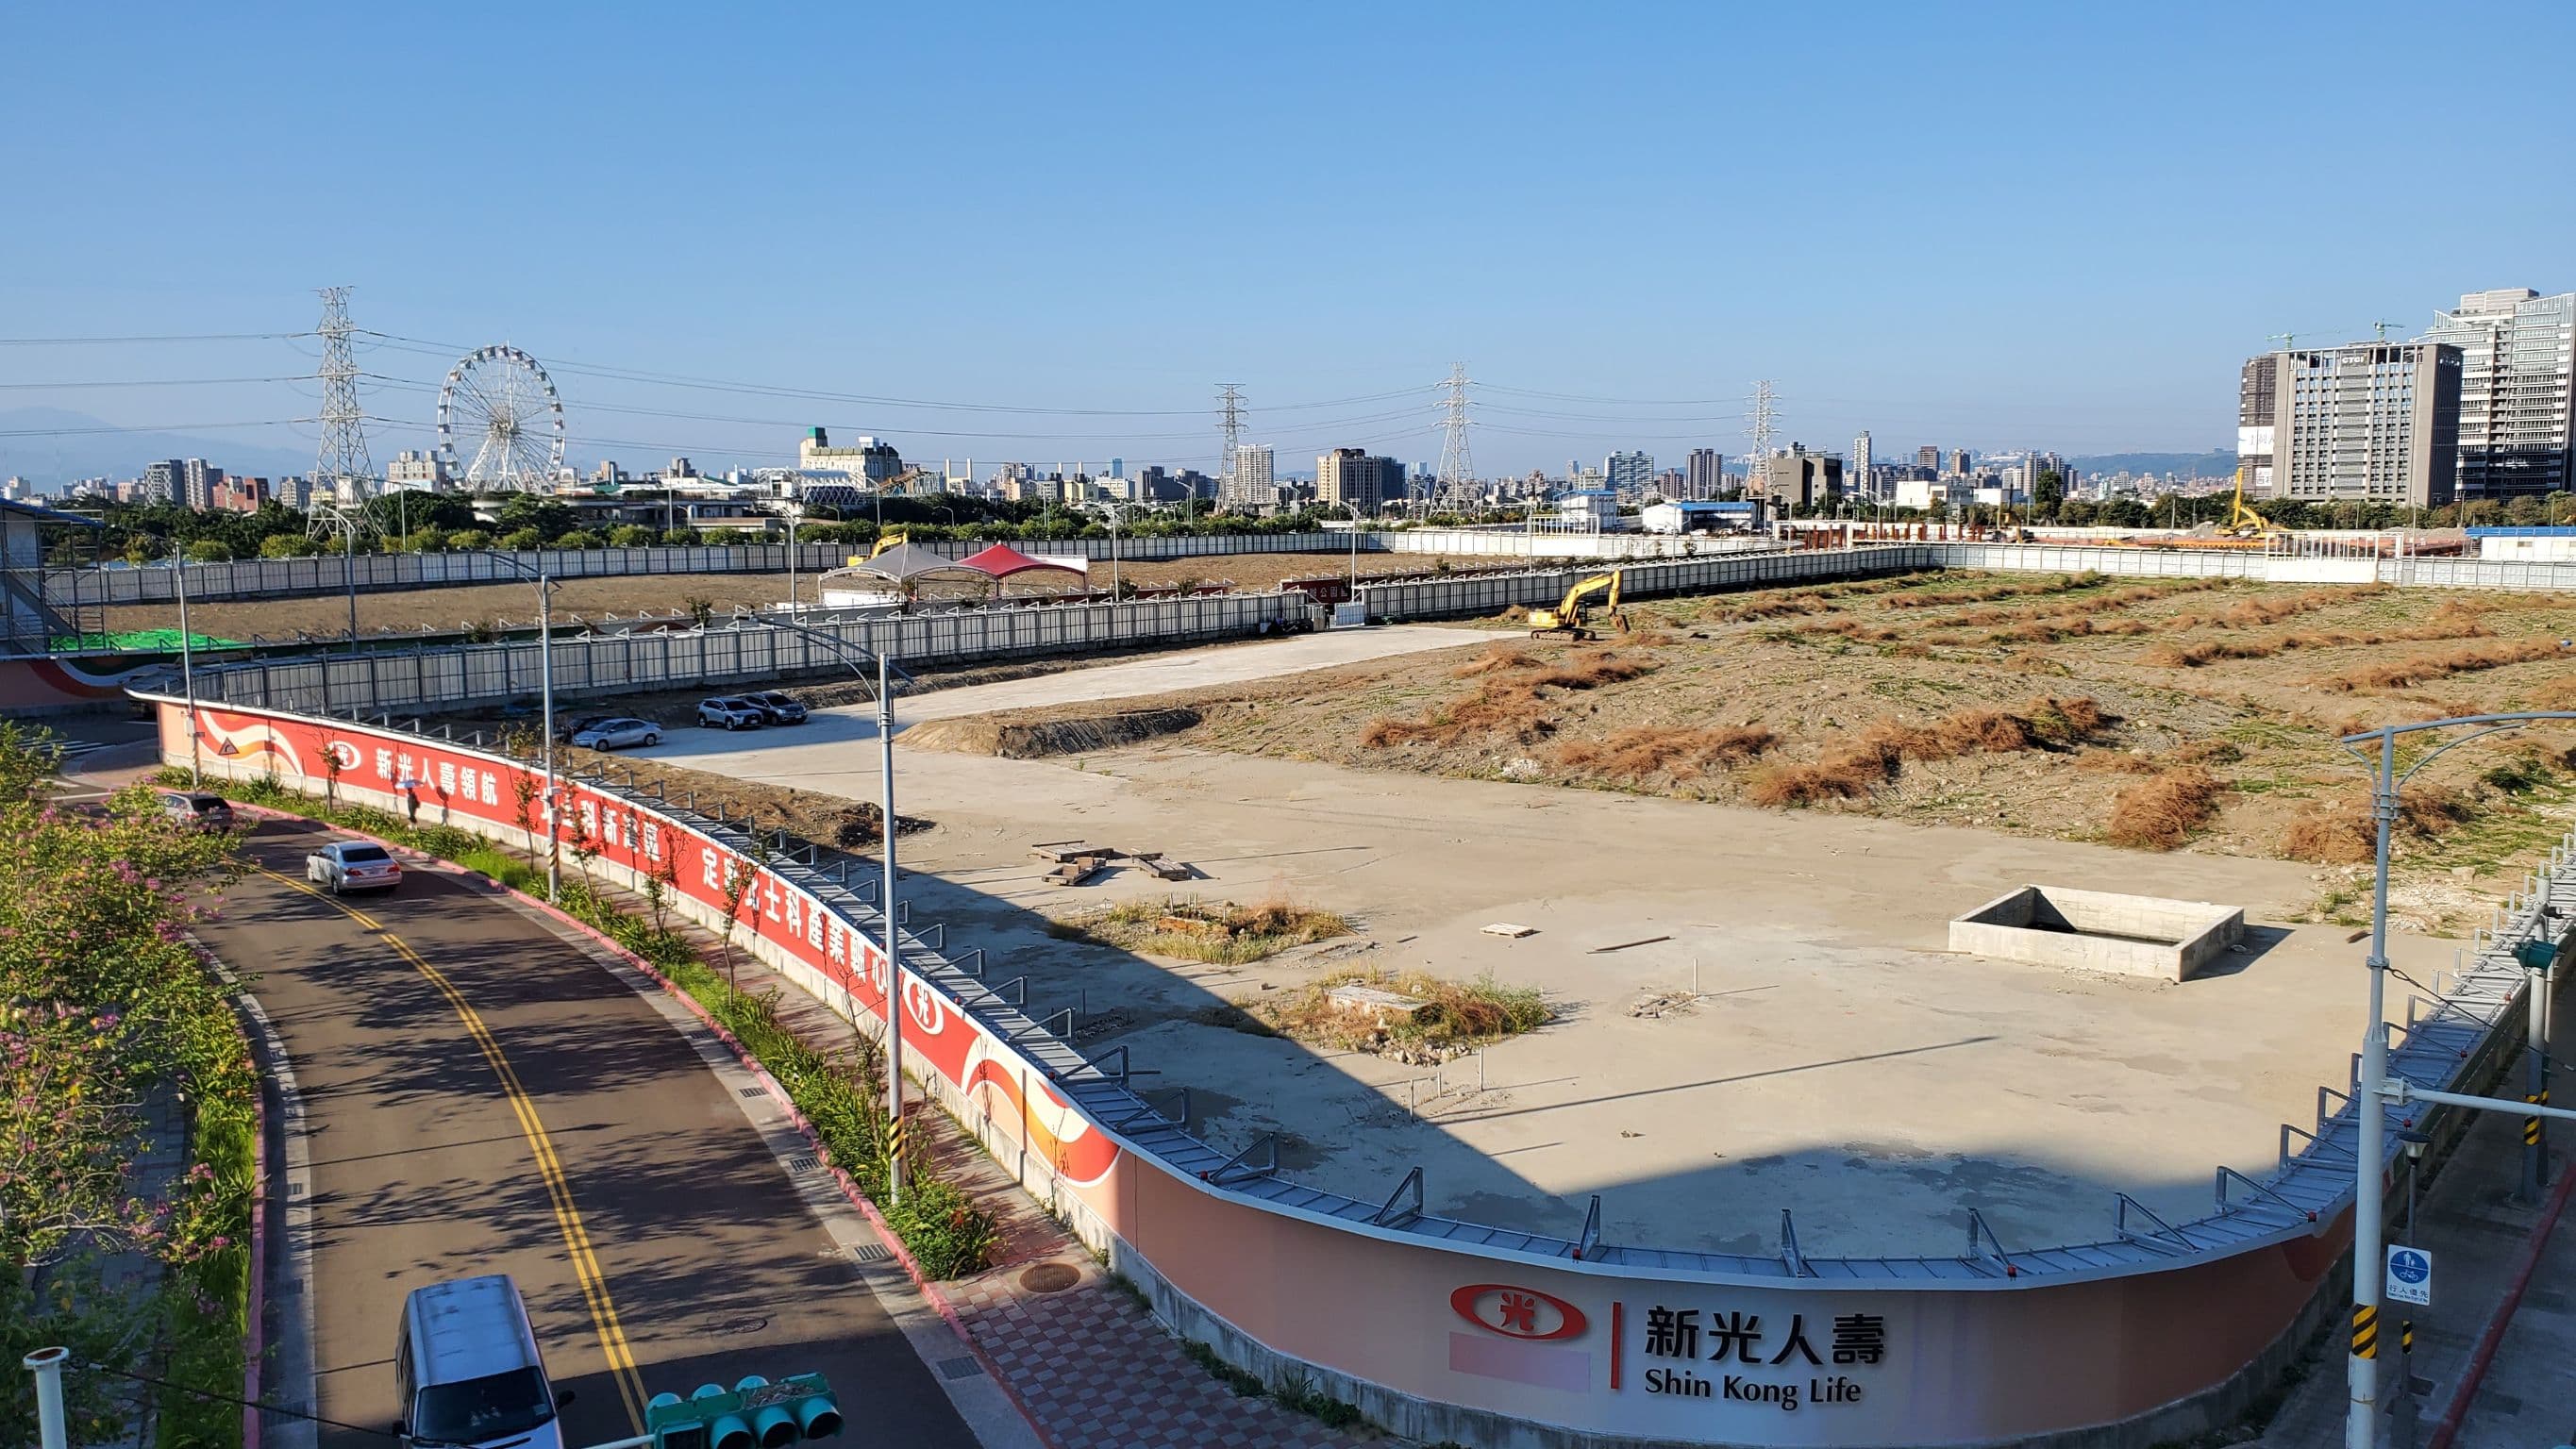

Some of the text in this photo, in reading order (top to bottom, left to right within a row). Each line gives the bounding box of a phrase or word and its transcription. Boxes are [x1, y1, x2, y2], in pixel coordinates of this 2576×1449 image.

[376, 747, 498, 807] 新光人壽領航
[2387, 1284, 2429, 1299] 行人優先
[1645, 1305, 1885, 1366] 新光人壽
[1645, 1368, 1862, 1411] Shin Kong Life
